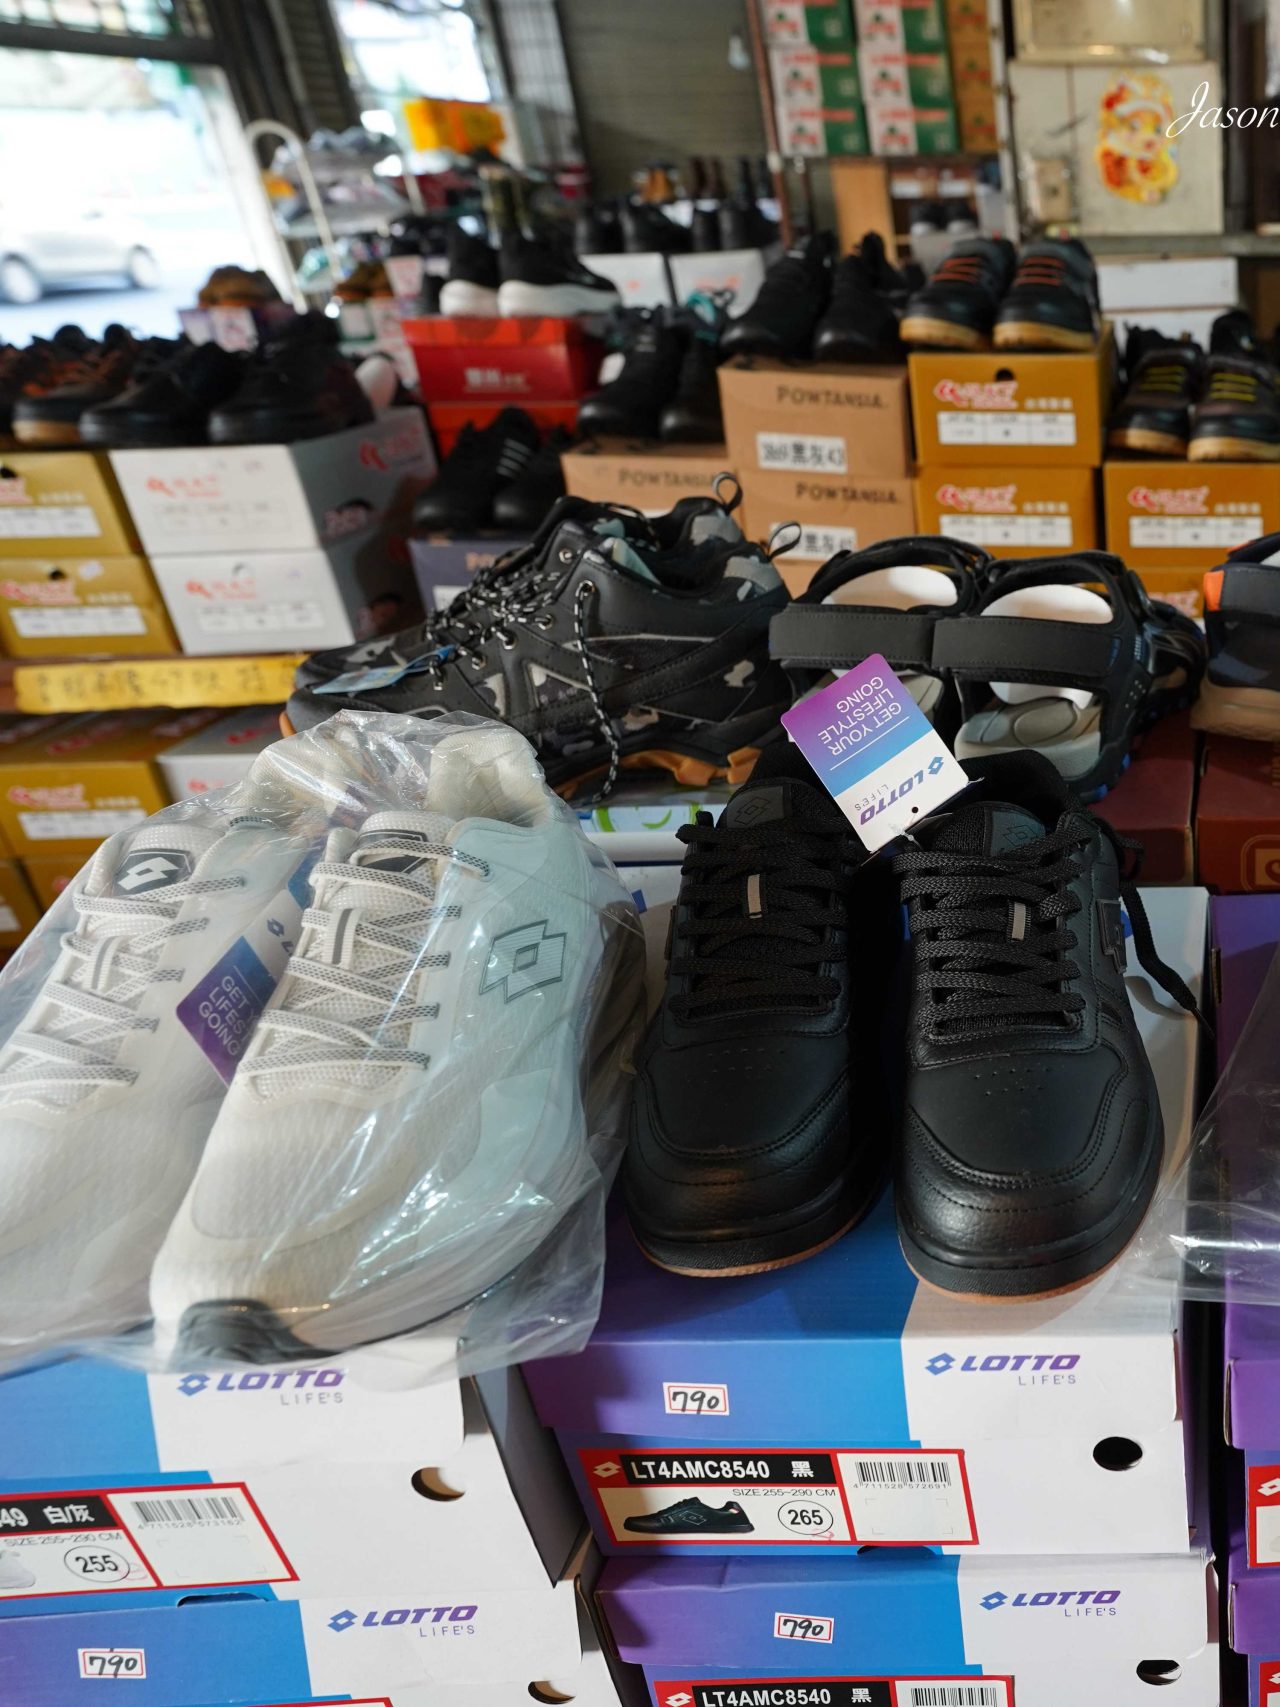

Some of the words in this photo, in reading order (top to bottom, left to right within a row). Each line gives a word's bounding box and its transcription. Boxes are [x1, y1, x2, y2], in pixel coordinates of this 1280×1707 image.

[837, 676, 883, 713] GOING
[818, 688, 894, 744] LIFESTYLE
[875, 703, 901, 729] GET
[829, 724, 873, 756] YOUR
[860, 770, 924, 825] LOTTO
[222, 976, 249, 1009] GET
[199, 1002, 241, 1056] GOING
[961, 1355, 1080, 1371] LOTTO
[216, 1368, 346, 1391] LOTTO
[1019, 1375, 1076, 1385] LIFE'S
[280, 1391, 344, 1405] LIFE'S
[672, 1392, 720, 1414] 790
[630, 1459, 771, 1480] LT4AMC8540
[791, 1461, 815, 1478] 黑
[732, 1488, 760, 1497] SIZE
[815, 1488, 836, 1497] CM
[43, 1504, 95, 1524] 白/灰
[787, 1509, 823, 1526] 265
[75, 1555, 118, 1573] 255
[1013, 1590, 1121, 1606] LOTTO
[363, 1605, 478, 1627] LOTTO
[1064, 1607, 1116, 1616] LIFE'S
[419, 1624, 475, 1638] LIFE'S
[782, 1619, 824, 1639] 790
[90, 1652, 139, 1677] 790
[702, 1689, 831, 1707] LT4AMC8540
[852, 1688, 871, 1703] 黑
